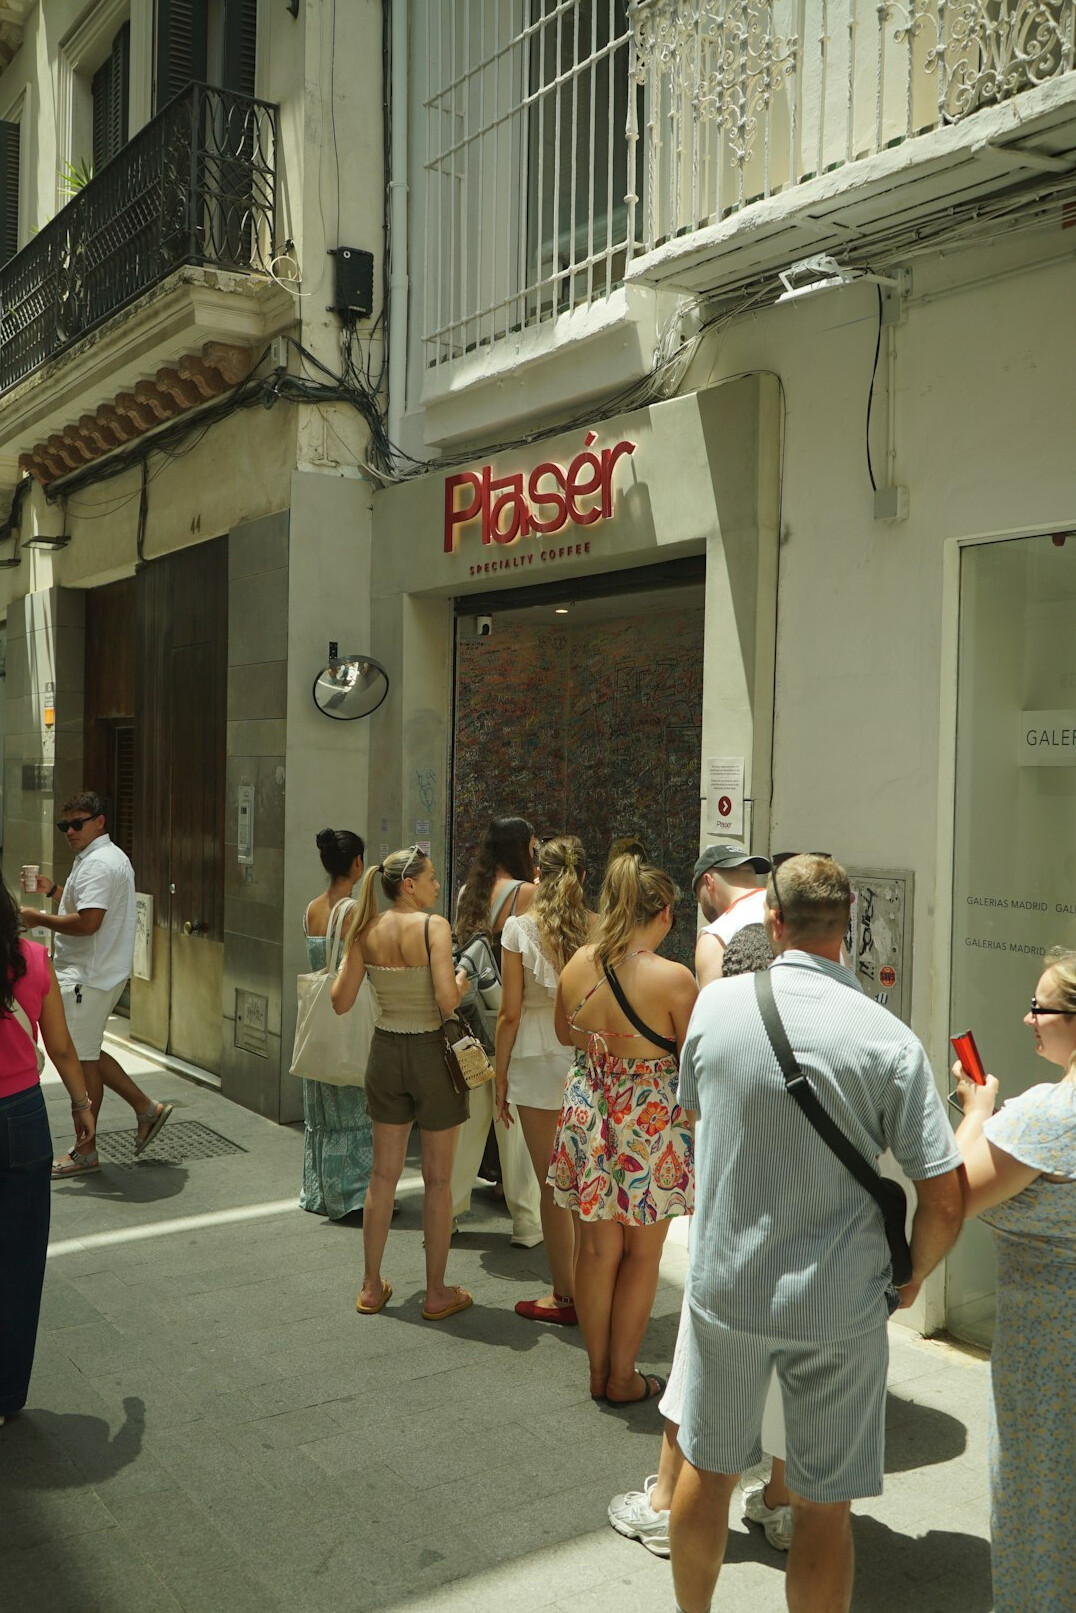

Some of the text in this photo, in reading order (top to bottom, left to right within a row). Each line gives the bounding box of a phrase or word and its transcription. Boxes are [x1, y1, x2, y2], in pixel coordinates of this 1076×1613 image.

[444, 430, 637, 552] Plasér
[469, 541, 591, 576] SPECIALTY COFFEE
[966, 896, 1076, 915] GALERIAS MADRID GAL
[965, 938, 1007, 951] GALERIAS
[1009, 943, 1046, 956] MADRID
